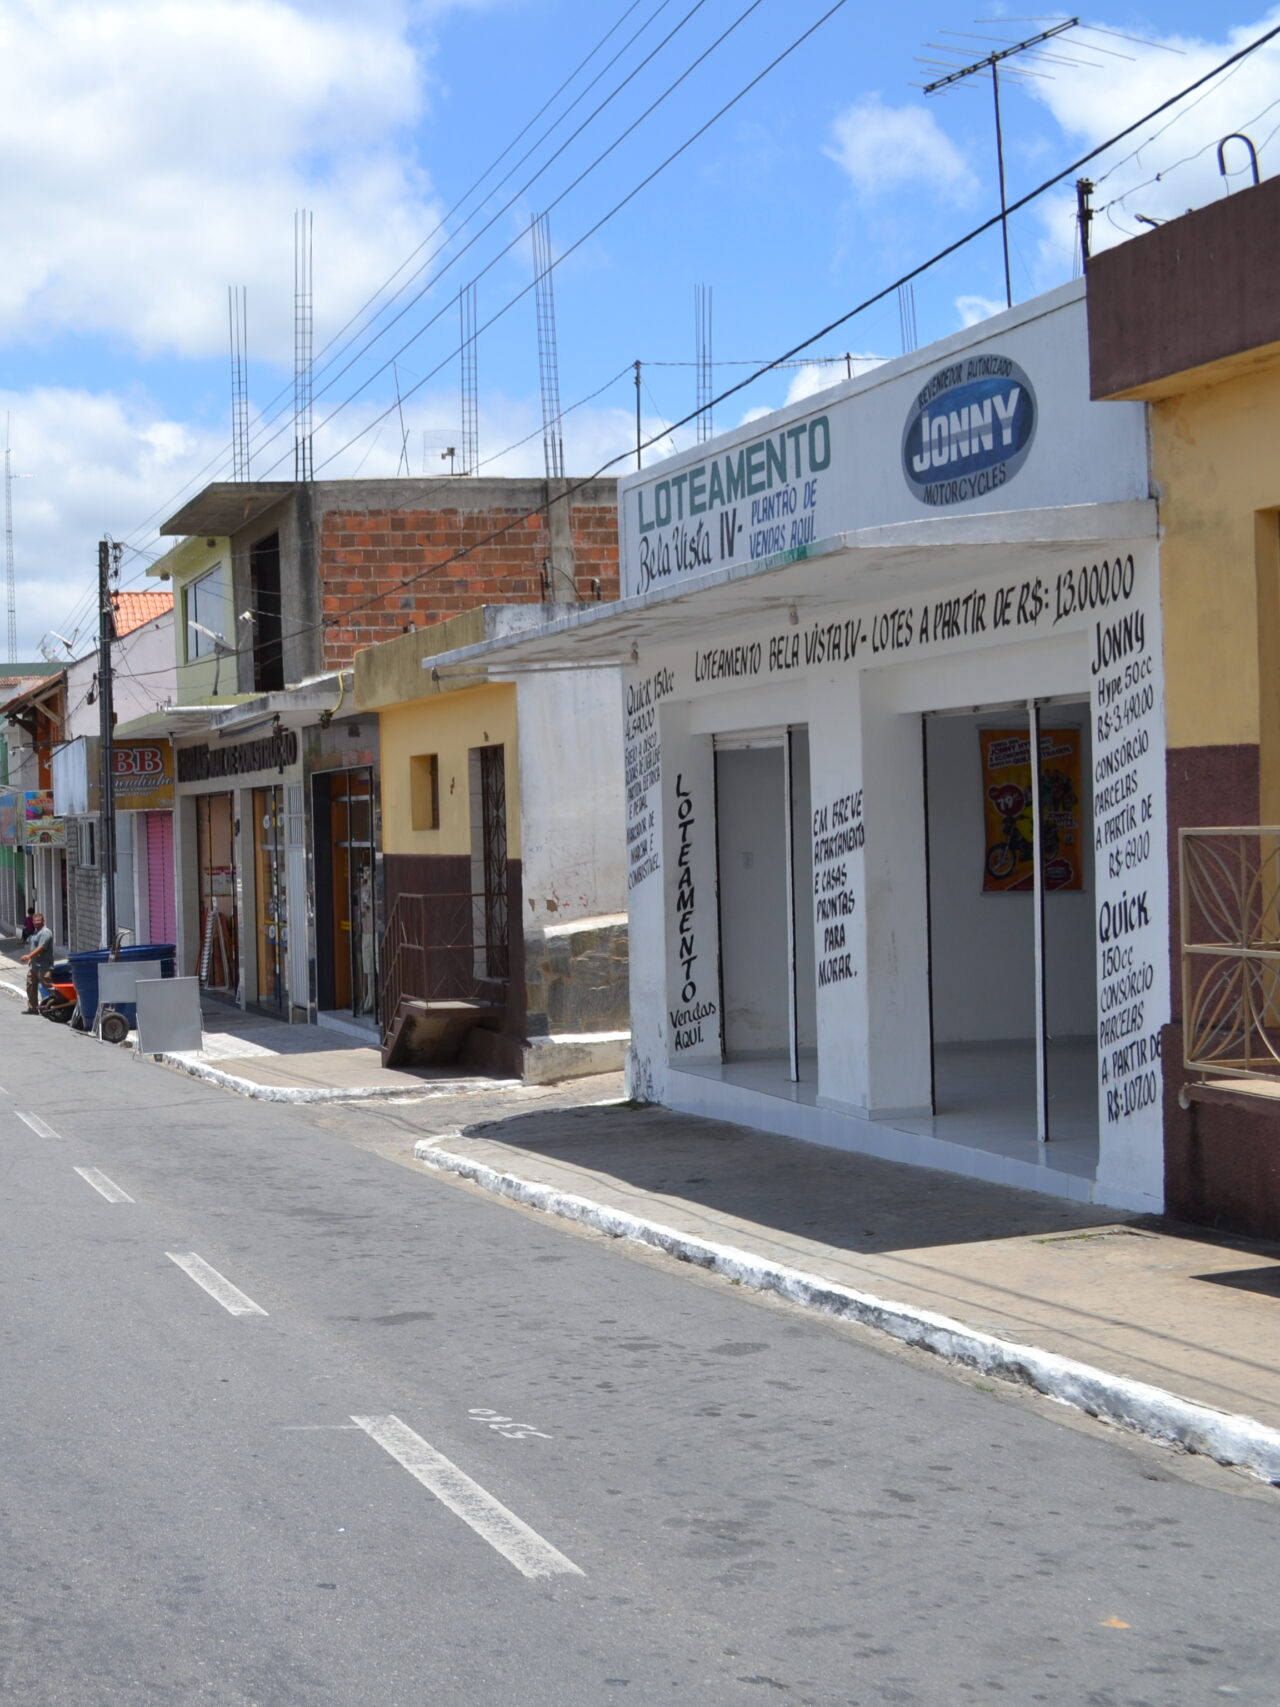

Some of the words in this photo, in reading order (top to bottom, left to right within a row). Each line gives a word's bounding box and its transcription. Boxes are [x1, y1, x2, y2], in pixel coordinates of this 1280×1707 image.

[913, 387, 1020, 472] JONNY
[638, 415, 831, 534] LOTEAMENTO
[923, 462, 1007, 505] MOTORCYCLES
[751, 483, 797, 526] PLANTÃO
[803, 478, 818, 510] DE
[636, 533, 671, 595] Bela
[672, 518, 712, 572] Vista
[749, 524, 786, 559] VENDAS
[694, 641, 761, 683] LOTEAMENTO
[769, 632, 799, 672] BELA
[872, 607, 913, 653] LOTES
[919, 606, 929, 644] A
[993, 585, 1016, 629] DE
[1091, 609, 1145, 676] JONNY
[1097, 675, 1123, 708] Hype
[813, 805, 828, 837] EM
[831, 790, 863, 830] BREVE
[1094, 769, 1138, 817] PARCELAS
[1095, 825, 1102, 852] A
[1141, 793, 1153, 823] DE
[675, 773, 699, 1003] LOTEAMENTO
[814, 871, 820, 894] E
[821, 862, 847, 893] CASAS
[816, 888, 856, 923] PRONTAS
[824, 922, 846, 953] PARA
[1102, 944, 1133, 980] 150cc
[669, 1001, 716, 1029] Vendas
[1100, 1000, 1144, 1049] PARCELAS
[1101, 1056, 1109, 1086] A
[1112, 1038, 1148, 1079] PARTIR
